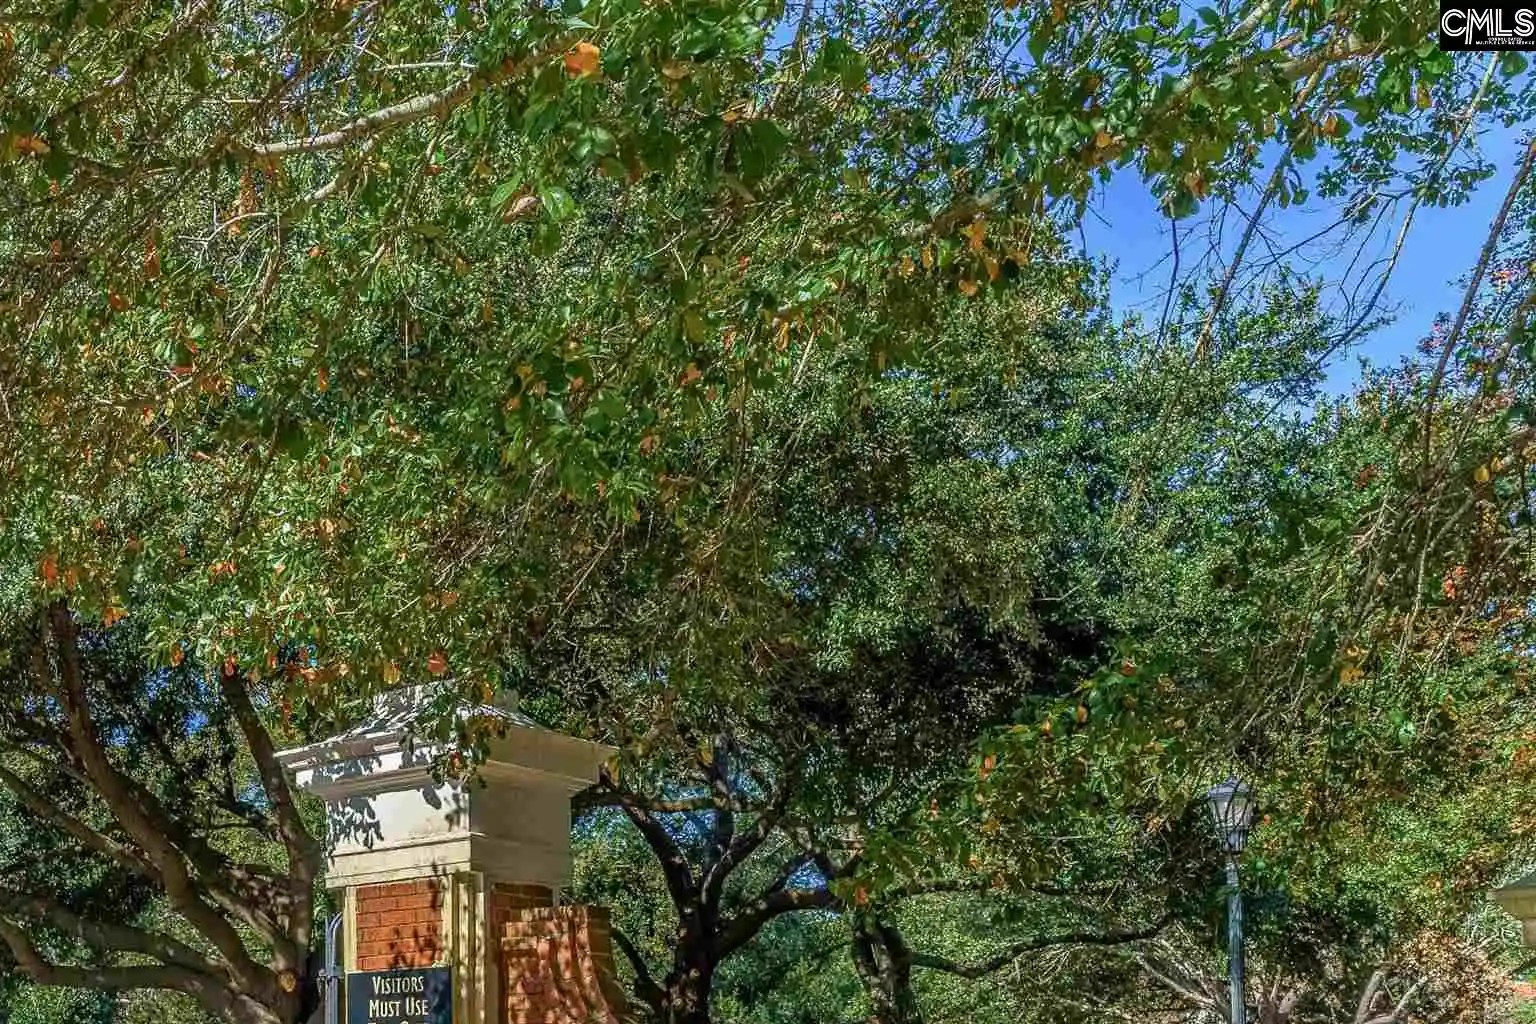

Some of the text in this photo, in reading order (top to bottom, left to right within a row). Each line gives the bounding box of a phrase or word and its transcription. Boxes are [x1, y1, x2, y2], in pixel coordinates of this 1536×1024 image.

[372, 976, 424, 994] VISITORS
[369, 997, 429, 1018] MUST USE
